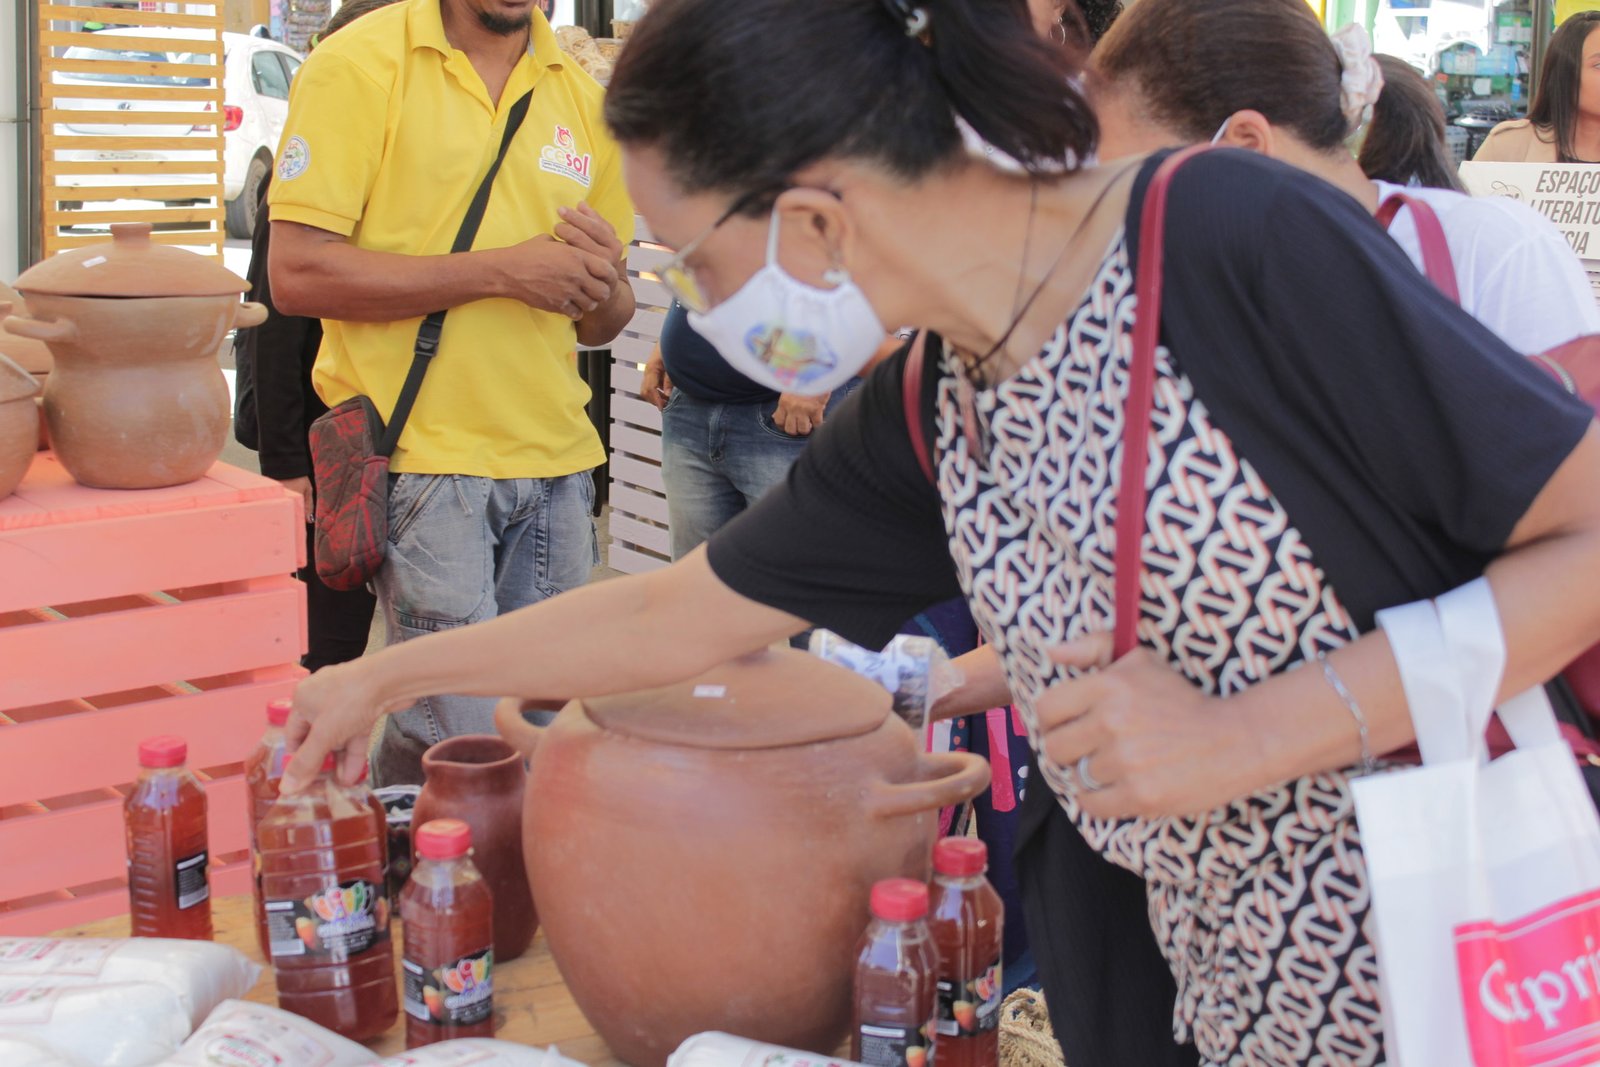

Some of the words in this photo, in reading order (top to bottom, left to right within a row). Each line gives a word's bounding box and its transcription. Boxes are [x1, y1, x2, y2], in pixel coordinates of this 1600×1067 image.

[1535, 170, 1600, 198] ESPAÇO
[1560, 230, 1590, 254] SIA
[1479, 934, 1600, 1031] Capri
